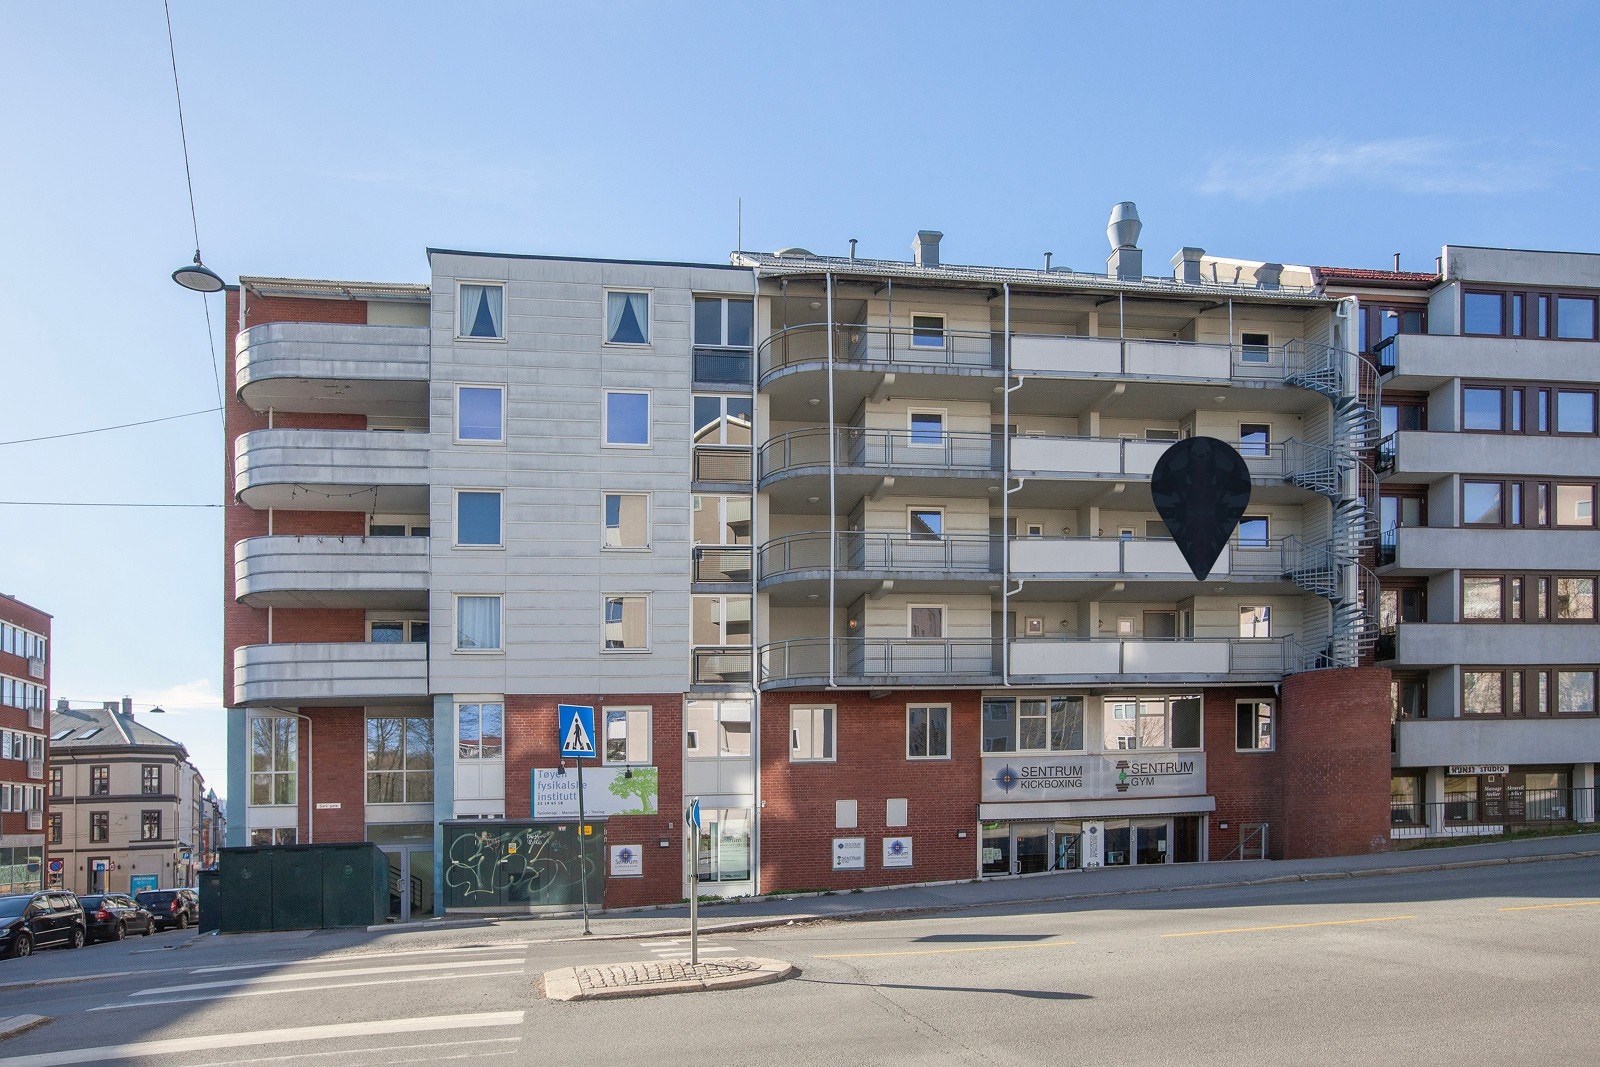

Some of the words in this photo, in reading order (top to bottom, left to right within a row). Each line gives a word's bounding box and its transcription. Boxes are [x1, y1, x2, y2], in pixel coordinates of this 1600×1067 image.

[1021, 765, 1083, 777] SENTRUM
[1131, 761, 1194, 774] SENTRUM
[1451, 766, 1475, 774] KUNST
[1480, 765, 1505, 773] STUDIO
[538, 770, 567, 780] Tøyen
[1021, 779, 1083, 790] KICKBOXING
[1131, 777, 1155, 787] GYM
[538, 792, 577, 801] institutt
